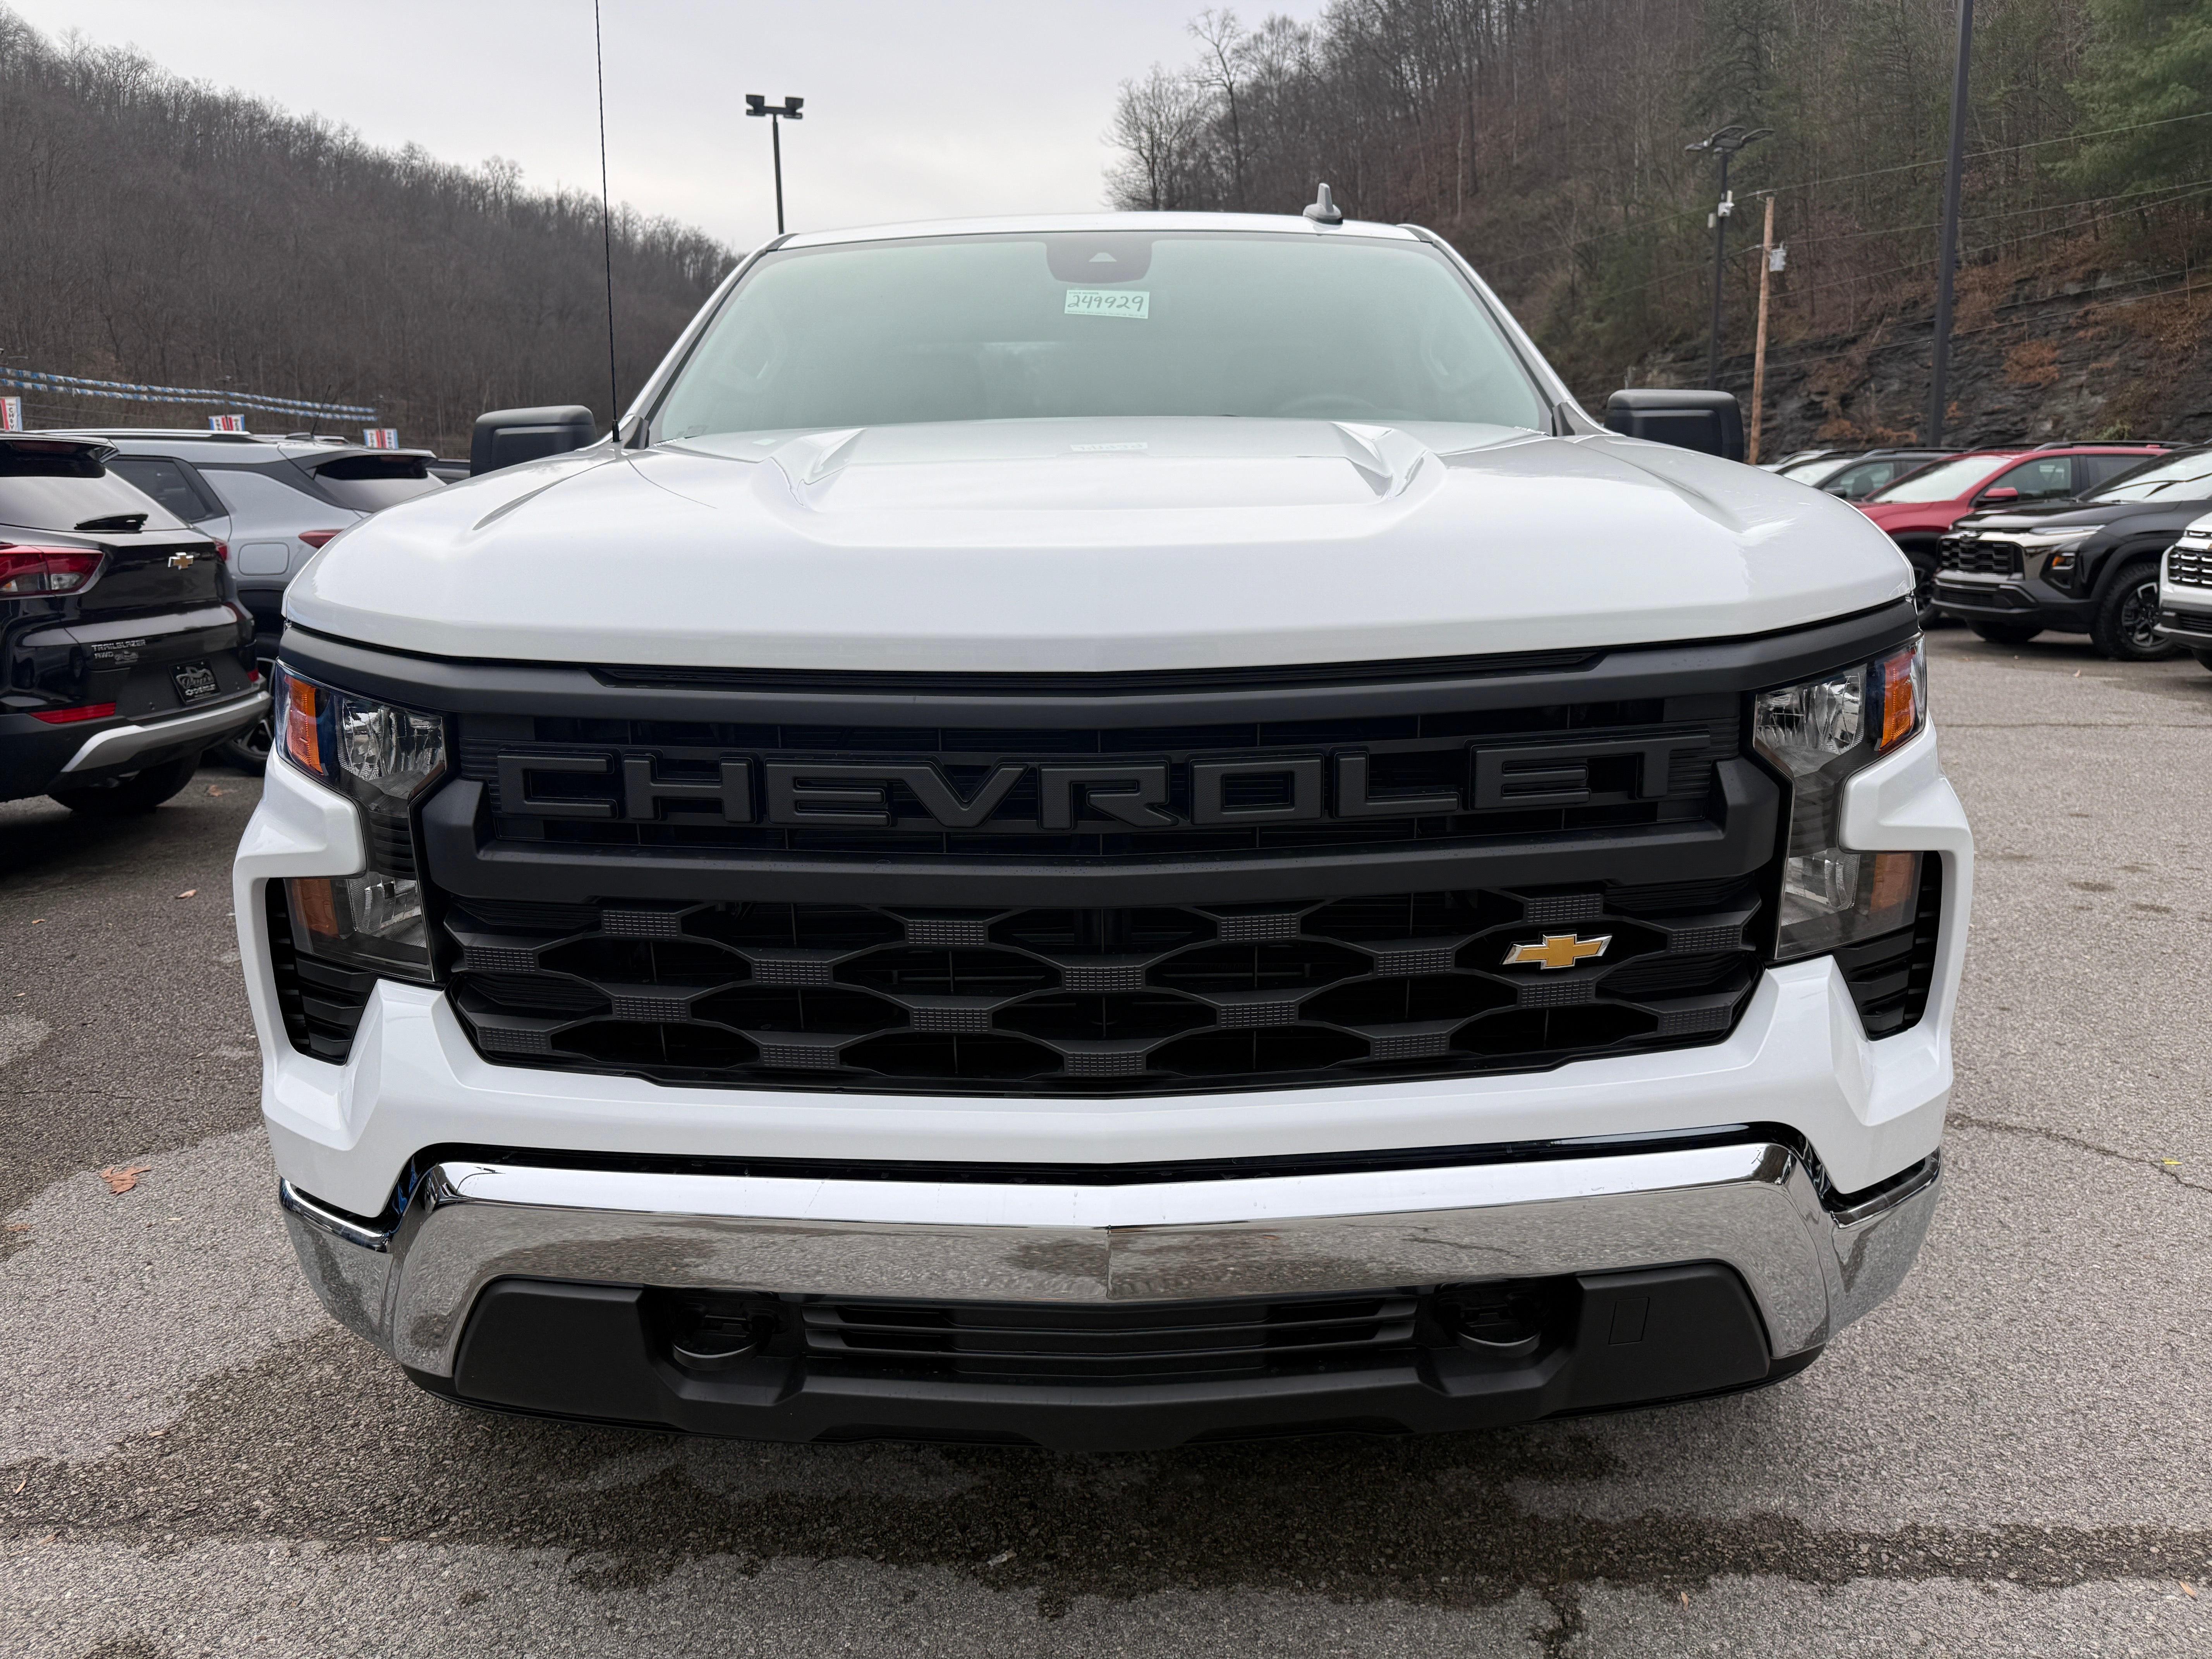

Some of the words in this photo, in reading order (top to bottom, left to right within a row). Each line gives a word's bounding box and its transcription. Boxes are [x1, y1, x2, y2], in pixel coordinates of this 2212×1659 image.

[1068, 295, 1144, 312] 249929
[91, 639, 146, 651] TRAILBLAZER
[497, 735, 1710, 829] CHEVROLET
